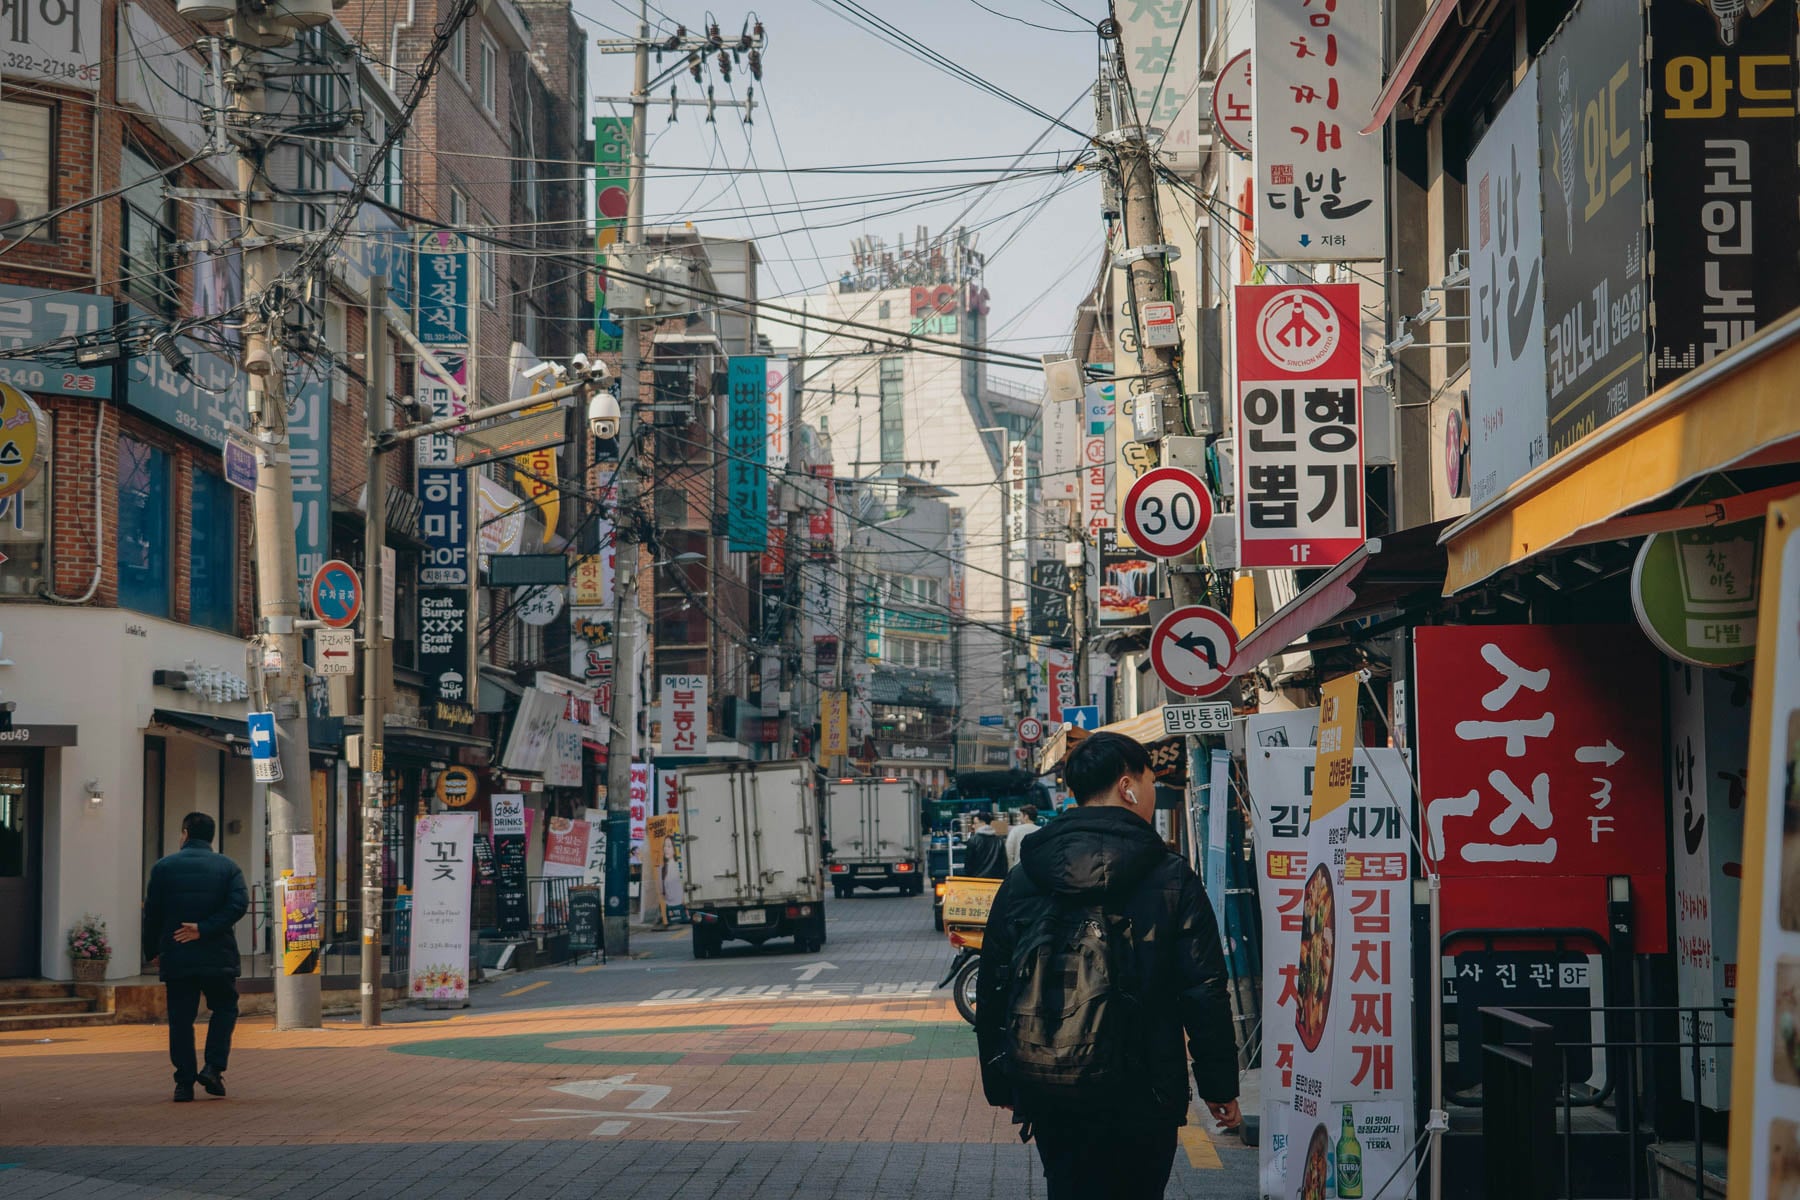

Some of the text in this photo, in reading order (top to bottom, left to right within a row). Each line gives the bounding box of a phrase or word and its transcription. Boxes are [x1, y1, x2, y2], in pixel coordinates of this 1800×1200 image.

[1267, 168, 1373, 220] 다발
[1321, 235, 1346, 247] 지하
[429, 254, 462, 331] 한정식
[910, 284, 957, 315] PC
[1611, 283, 1641, 346] 연습장
[1550, 277, 1609, 399] 코인노래
[1286, 356, 1316, 367] SINCHON
[62, 373, 96, 391] 2층
[1243, 387, 1357, 453] 인형
[1247, 464, 1359, 529] 뽑기
[1141, 492, 1196, 535] 30
[421, 547, 466, 565] HOF
[1289, 544, 1311, 563] 1F
[1705, 548, 1727, 571] 참
[581, 564, 597, 592] 하숙
[1709, 571, 1737, 596] 이슬
[319, 590, 355, 601] 주차금지
[421, 598, 453, 608] Craft
[421, 609, 465, 620] Burger
[422, 620, 464, 632] XXX
[1704, 622, 1742, 643] 다발
[319, 634, 351, 646] 구간시작
[421, 633, 453, 644] Craft
[421, 644, 452, 653] Beer
[323, 663, 348, 673] 210m
[664, 677, 704, 689] 에이스
[672, 690, 698, 752] 부동산
[1166, 707, 1230, 729] 일방통행
[1023, 724, 1038, 735] 30
[494, 801, 521, 818] Good
[494, 817, 523, 827] DRINKS
[424, 841, 465, 881] 꽃
[1269, 854, 1307, 877] 밥도
[1459, 962, 1588, 988] 사진관 3F
[1348, 889, 1395, 1091] 김치찌개
[1364, 1115, 1392, 1126] 이 맛이
[1272, 1133, 1288, 1152] 진로
[1366, 1141, 1392, 1151] TERRA
[1338, 1163, 1361, 1173] TERRA
